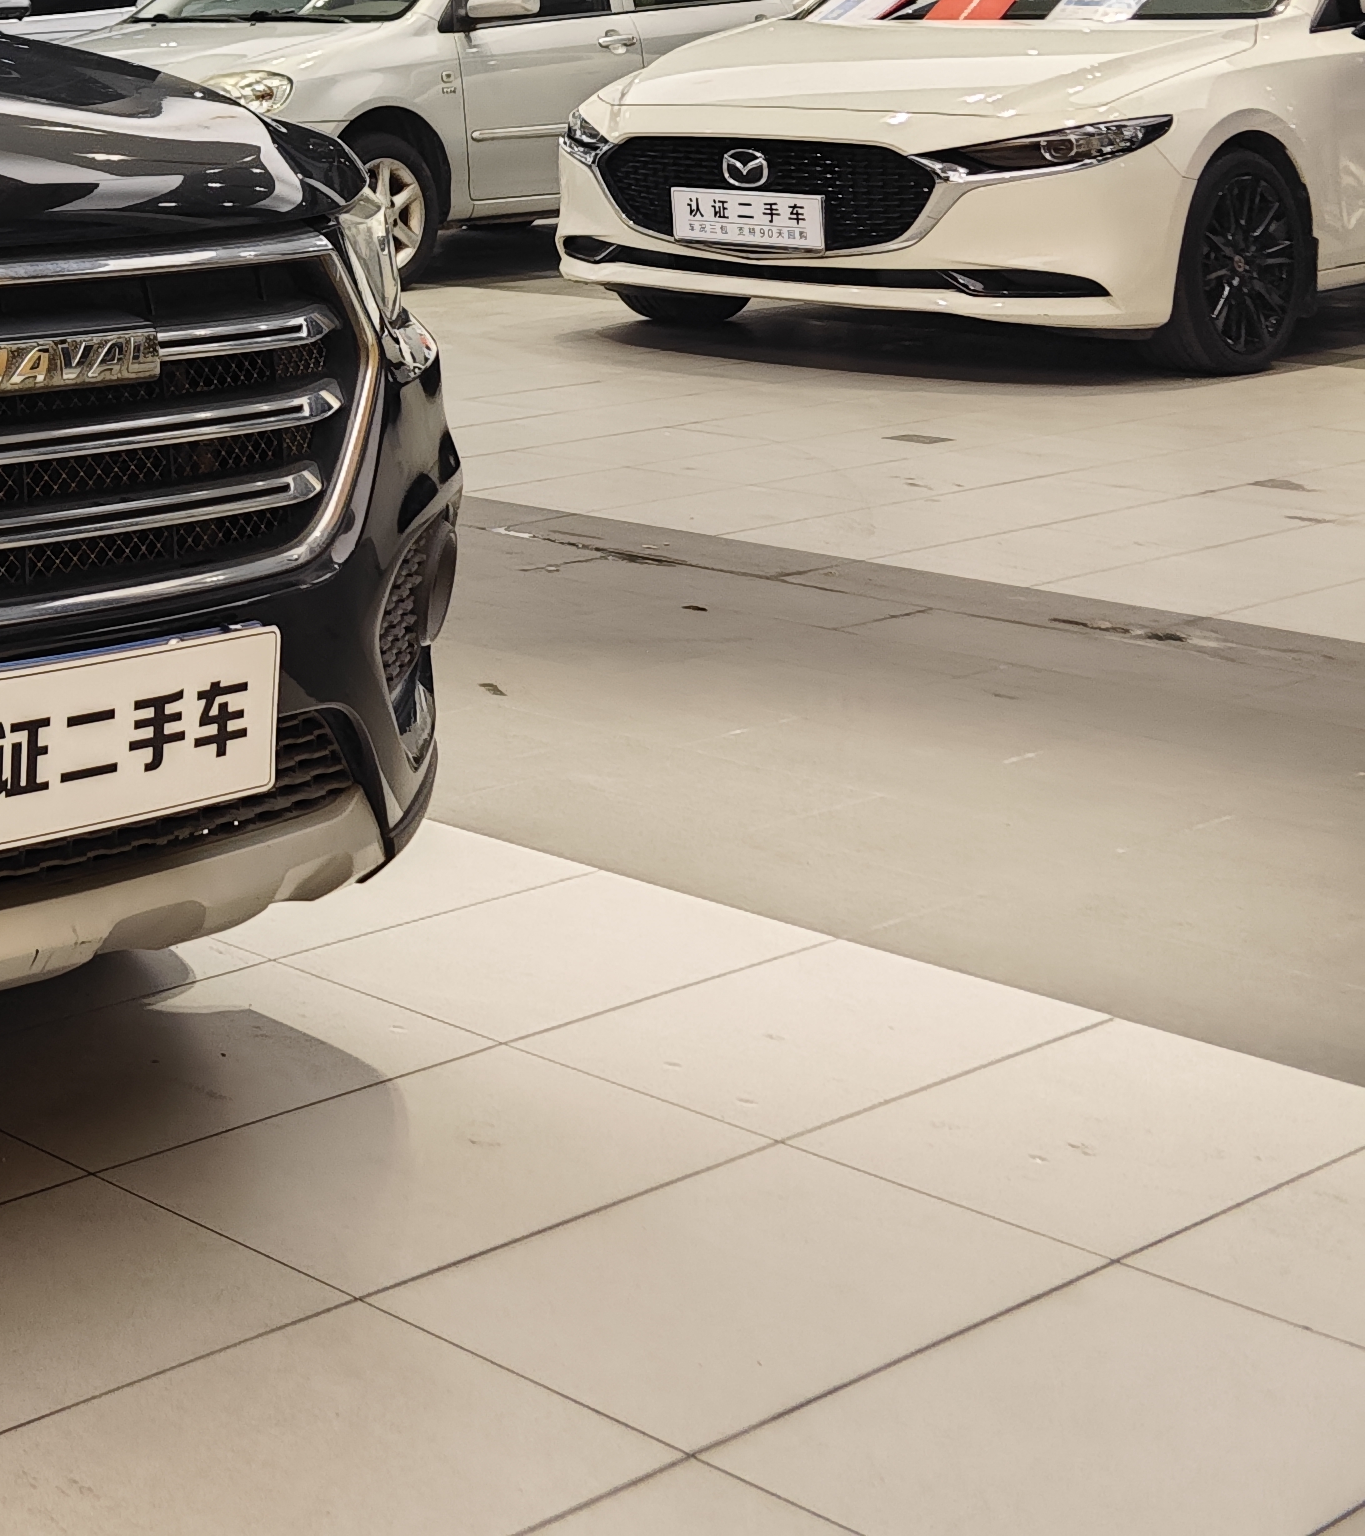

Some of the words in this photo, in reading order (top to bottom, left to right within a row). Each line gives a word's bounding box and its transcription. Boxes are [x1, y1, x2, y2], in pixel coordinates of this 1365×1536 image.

[687, 197, 806, 225] 认证二手车
[688, 223, 729, 235] 车况三包
[737, 226, 808, 240] 支持90天回购
